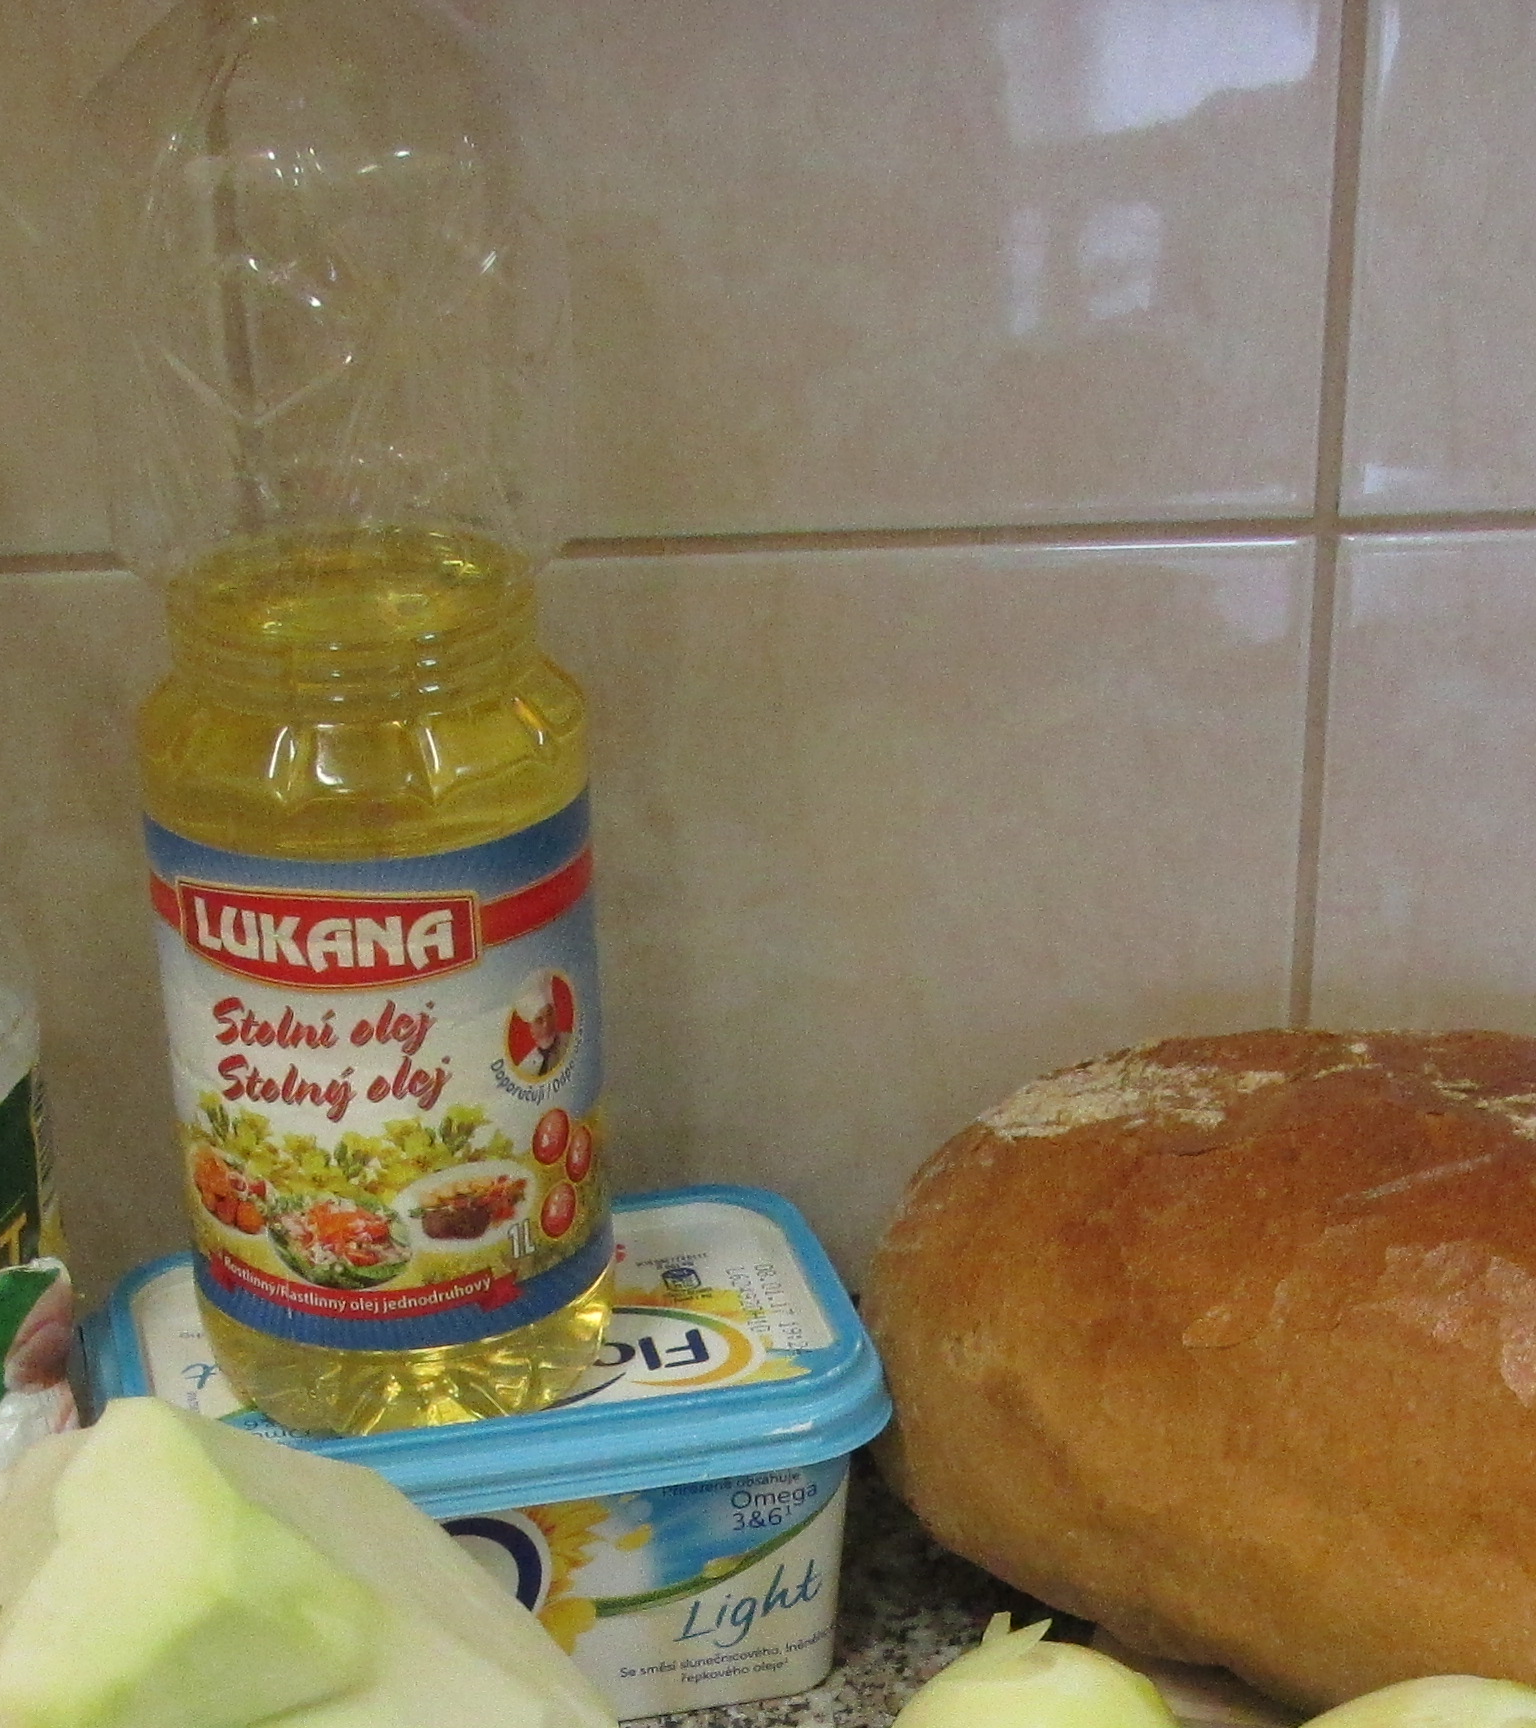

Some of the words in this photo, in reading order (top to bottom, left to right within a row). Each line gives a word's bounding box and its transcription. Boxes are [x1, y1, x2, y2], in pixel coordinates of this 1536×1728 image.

[194, 896, 454, 973] LUKANA
[213, 997, 339, 1049] Stolní
[350, 999, 438, 1055] olej
[218, 1053, 356, 1123] Stolný
[367, 1055, 453, 1111] olej
[508, 1218, 536, 1259] 1L
[350, 1298, 380, 1314] olej
[730, 1483, 818, 1510] Omega
[672, 1558, 823, 1648] Light
